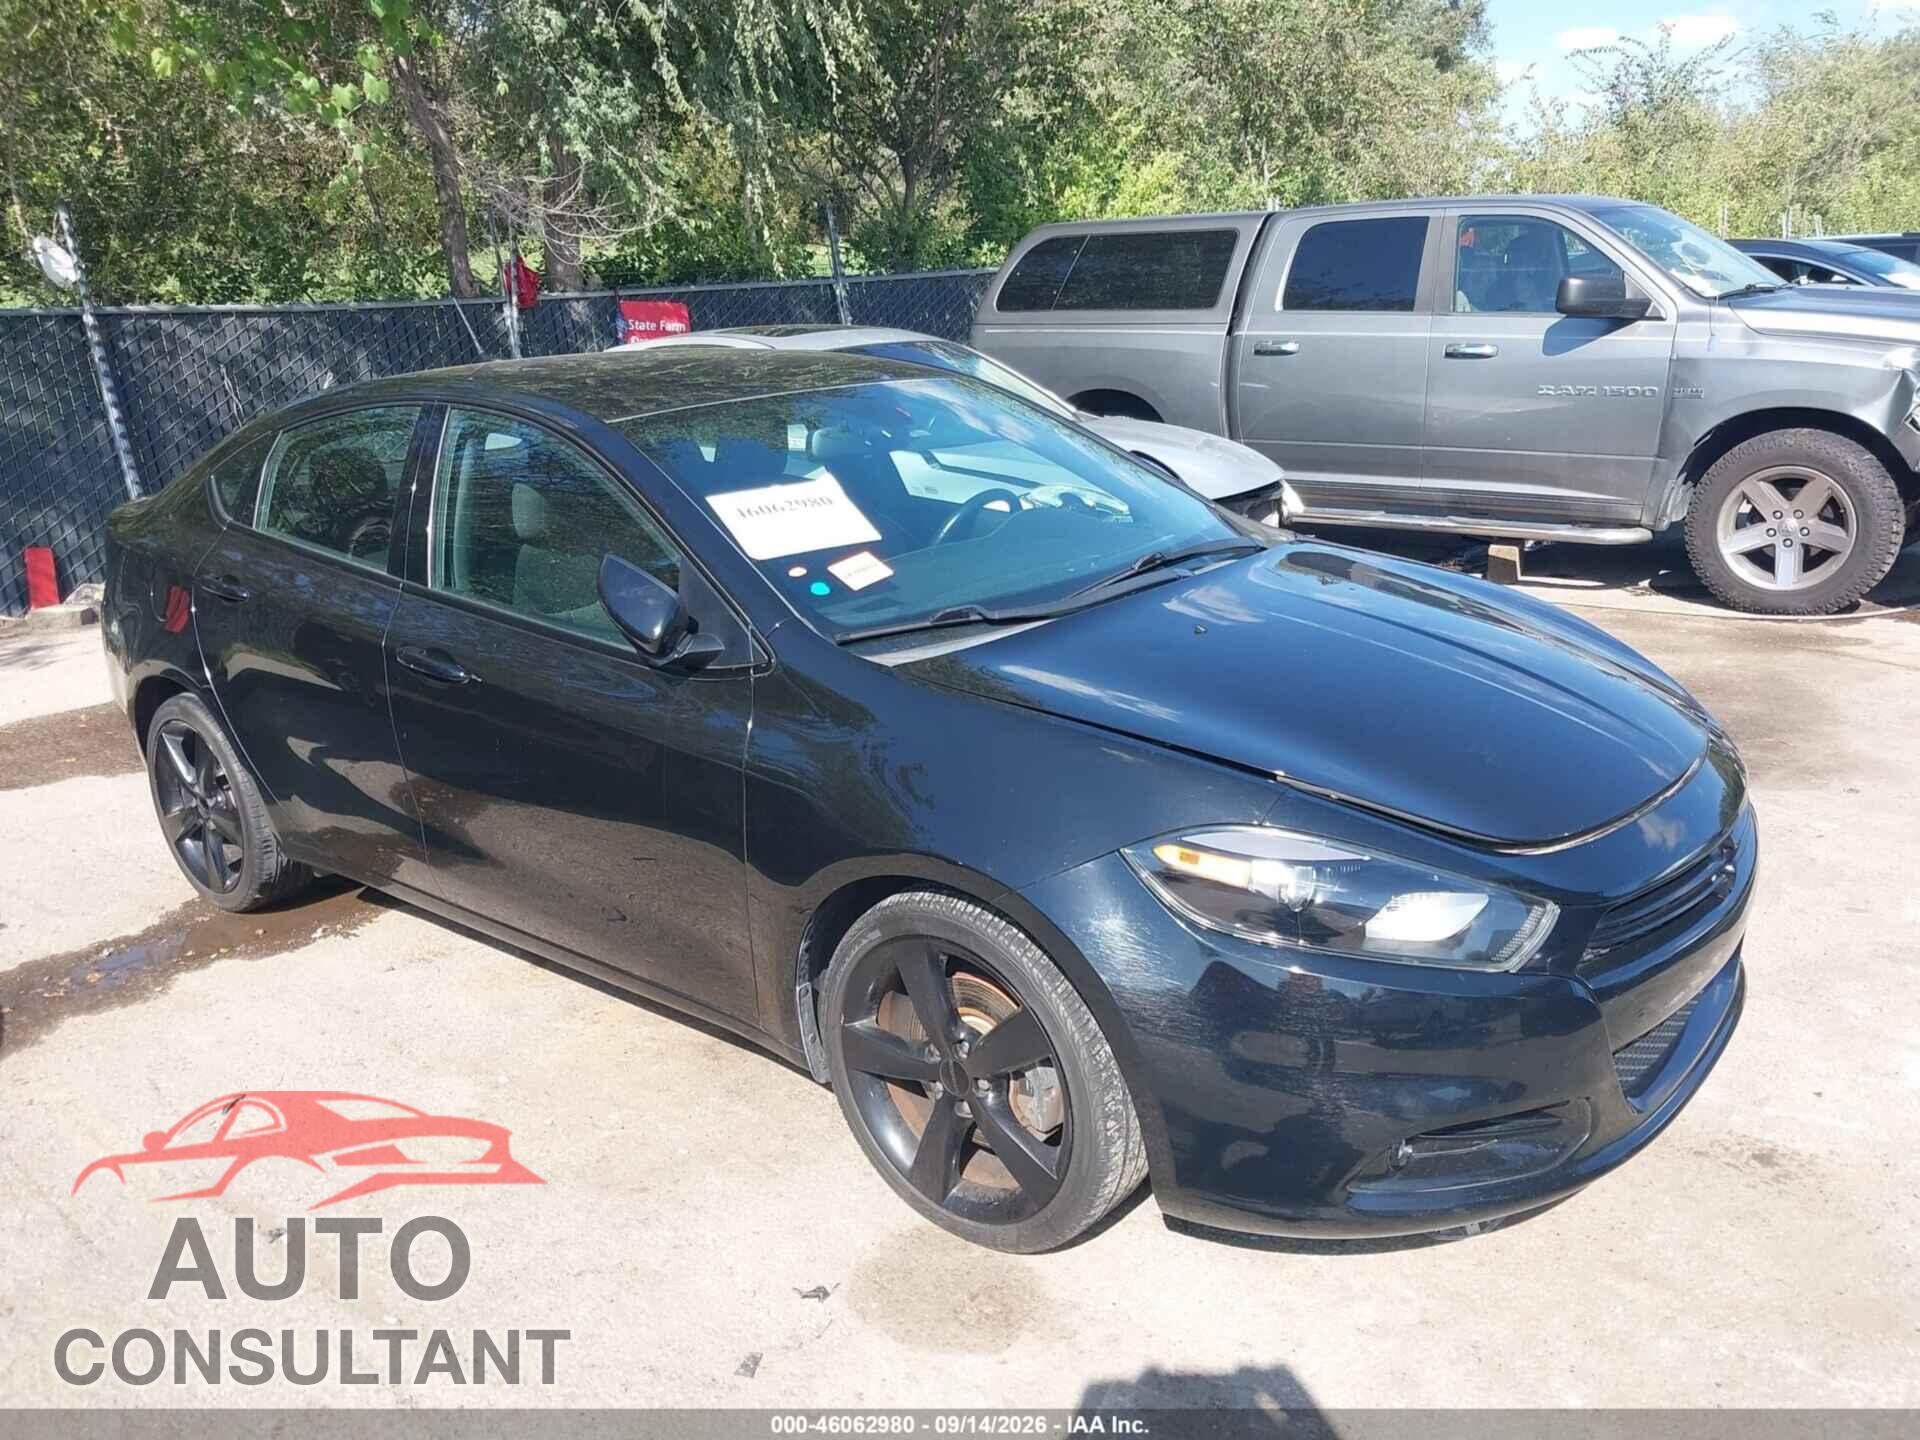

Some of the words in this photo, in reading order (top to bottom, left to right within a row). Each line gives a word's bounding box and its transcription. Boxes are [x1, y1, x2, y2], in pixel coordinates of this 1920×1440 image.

[628, 319, 657, 331] State
[659, 320, 686, 332] Farm
[1537, 384, 1597, 398] RAM
[1601, 385, 1659, 398] 1500
